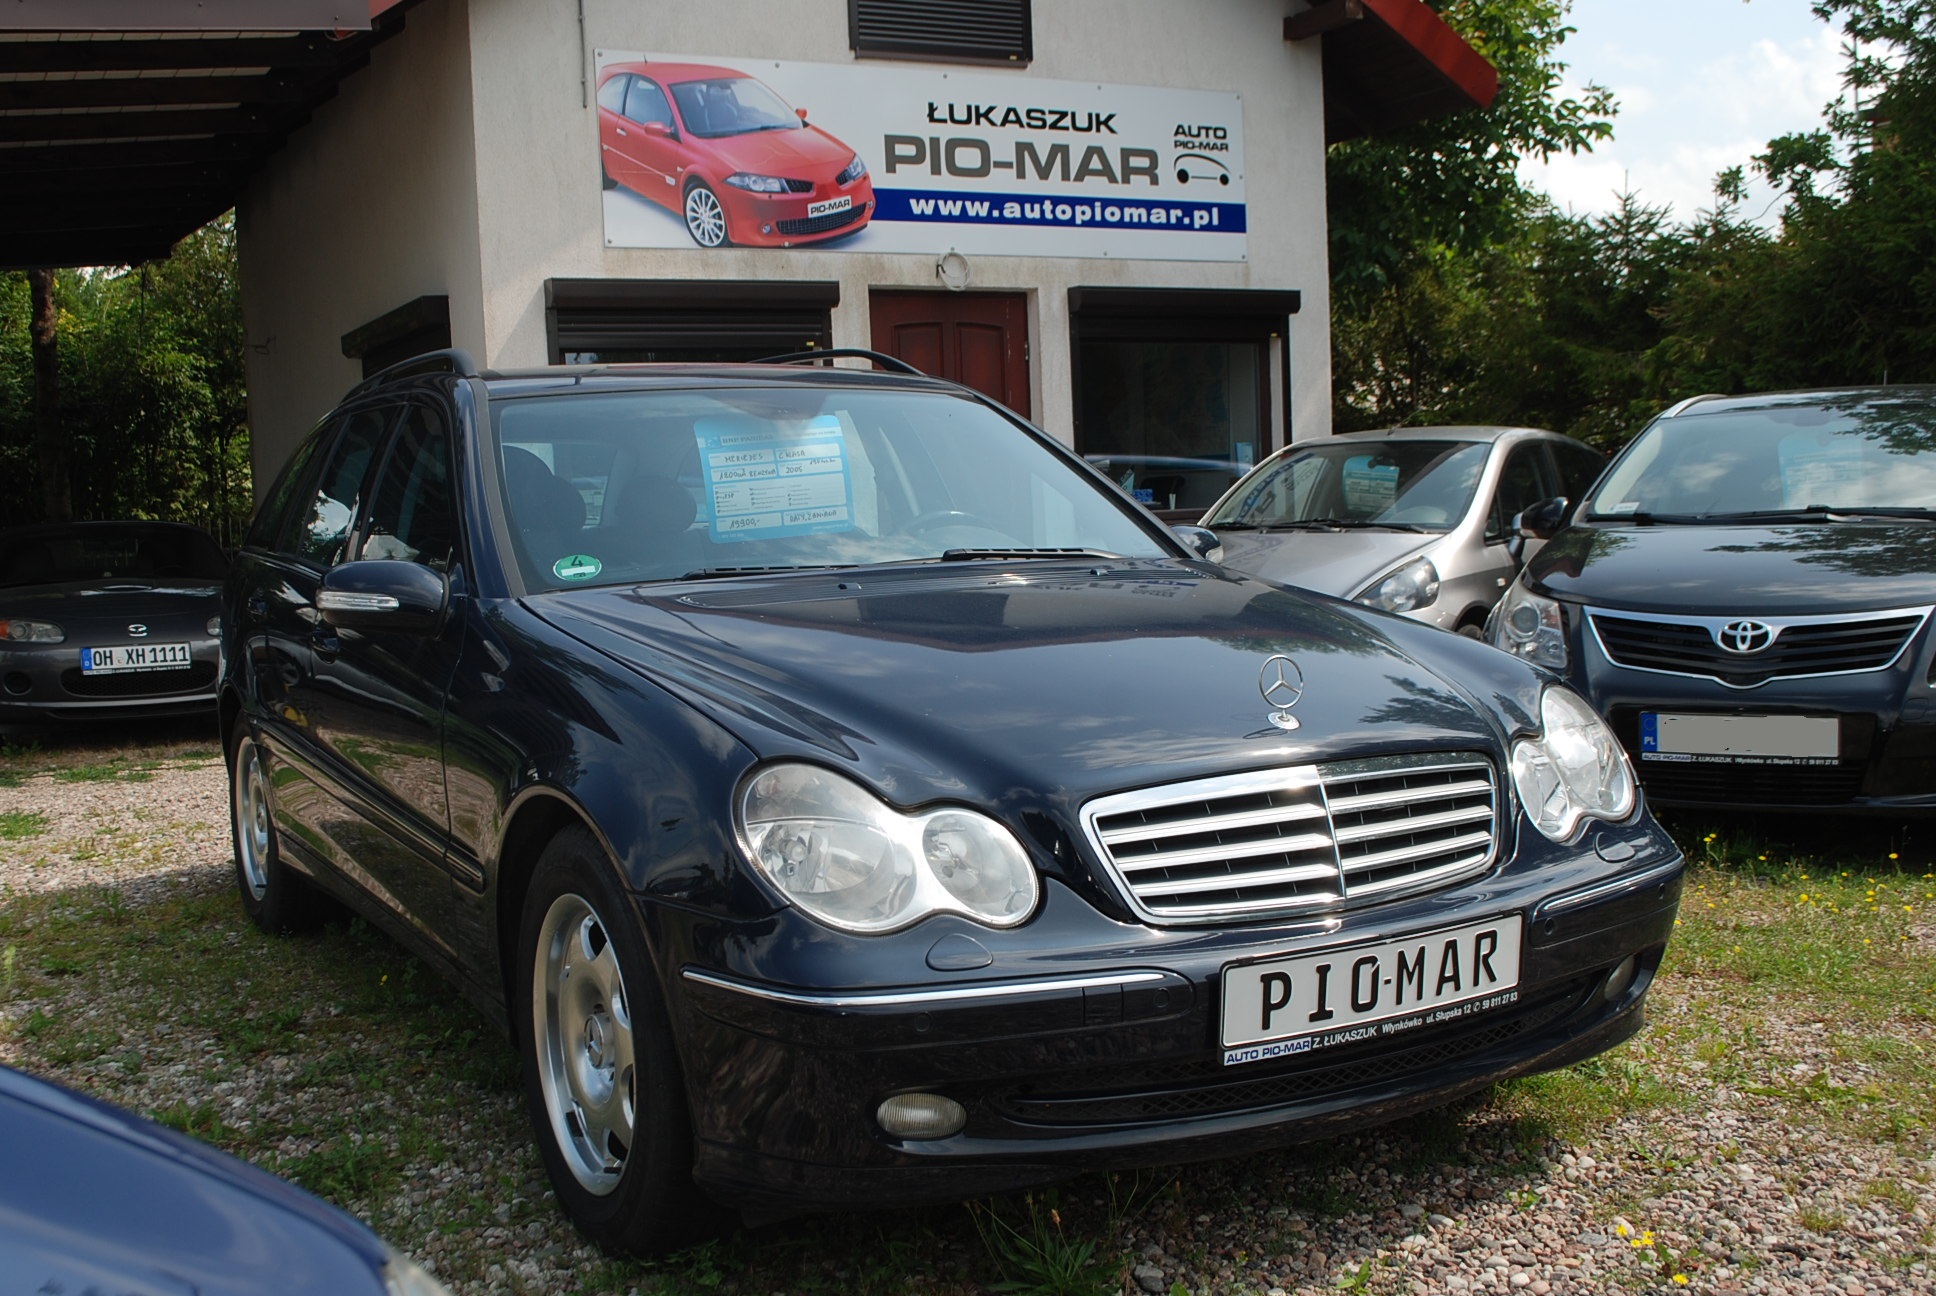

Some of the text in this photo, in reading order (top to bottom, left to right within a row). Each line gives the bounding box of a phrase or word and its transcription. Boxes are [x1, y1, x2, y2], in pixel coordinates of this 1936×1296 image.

[926, 101, 1118, 135] ŁUKASZUK
[1173, 124, 1228, 140] AUTO
[1173, 139, 1230, 153] PIO-MAR
[883, 133, 1160, 187] PIO-MAR
[809, 198, 851, 216] PIO-MAR
[908, 197, 1220, 230] www.autopiomar.pl
[570, 555, 584, 568] 4
[93, 646, 189, 667] OH XH 1111
[1643, 736, 1656, 746] PL
[1260, 928, 1498, 1031] PIO-MAR
[1226, 1048, 1259, 1064] AUTO
[1262, 1039, 1311, 1059] PIO-MAR
[1312, 1037, 1323, 1049] Z.
[1323, 1024, 1378, 1047] ŁUKASZUK
[1382, 1017, 1423, 1035] Włynkówko
[1435, 1006, 1463, 1021] Słupska
[1463, 1004, 1471, 1014] 12
[1490, 995, 1501, 1007] 811
[1501, 993, 1510, 1004] 27
